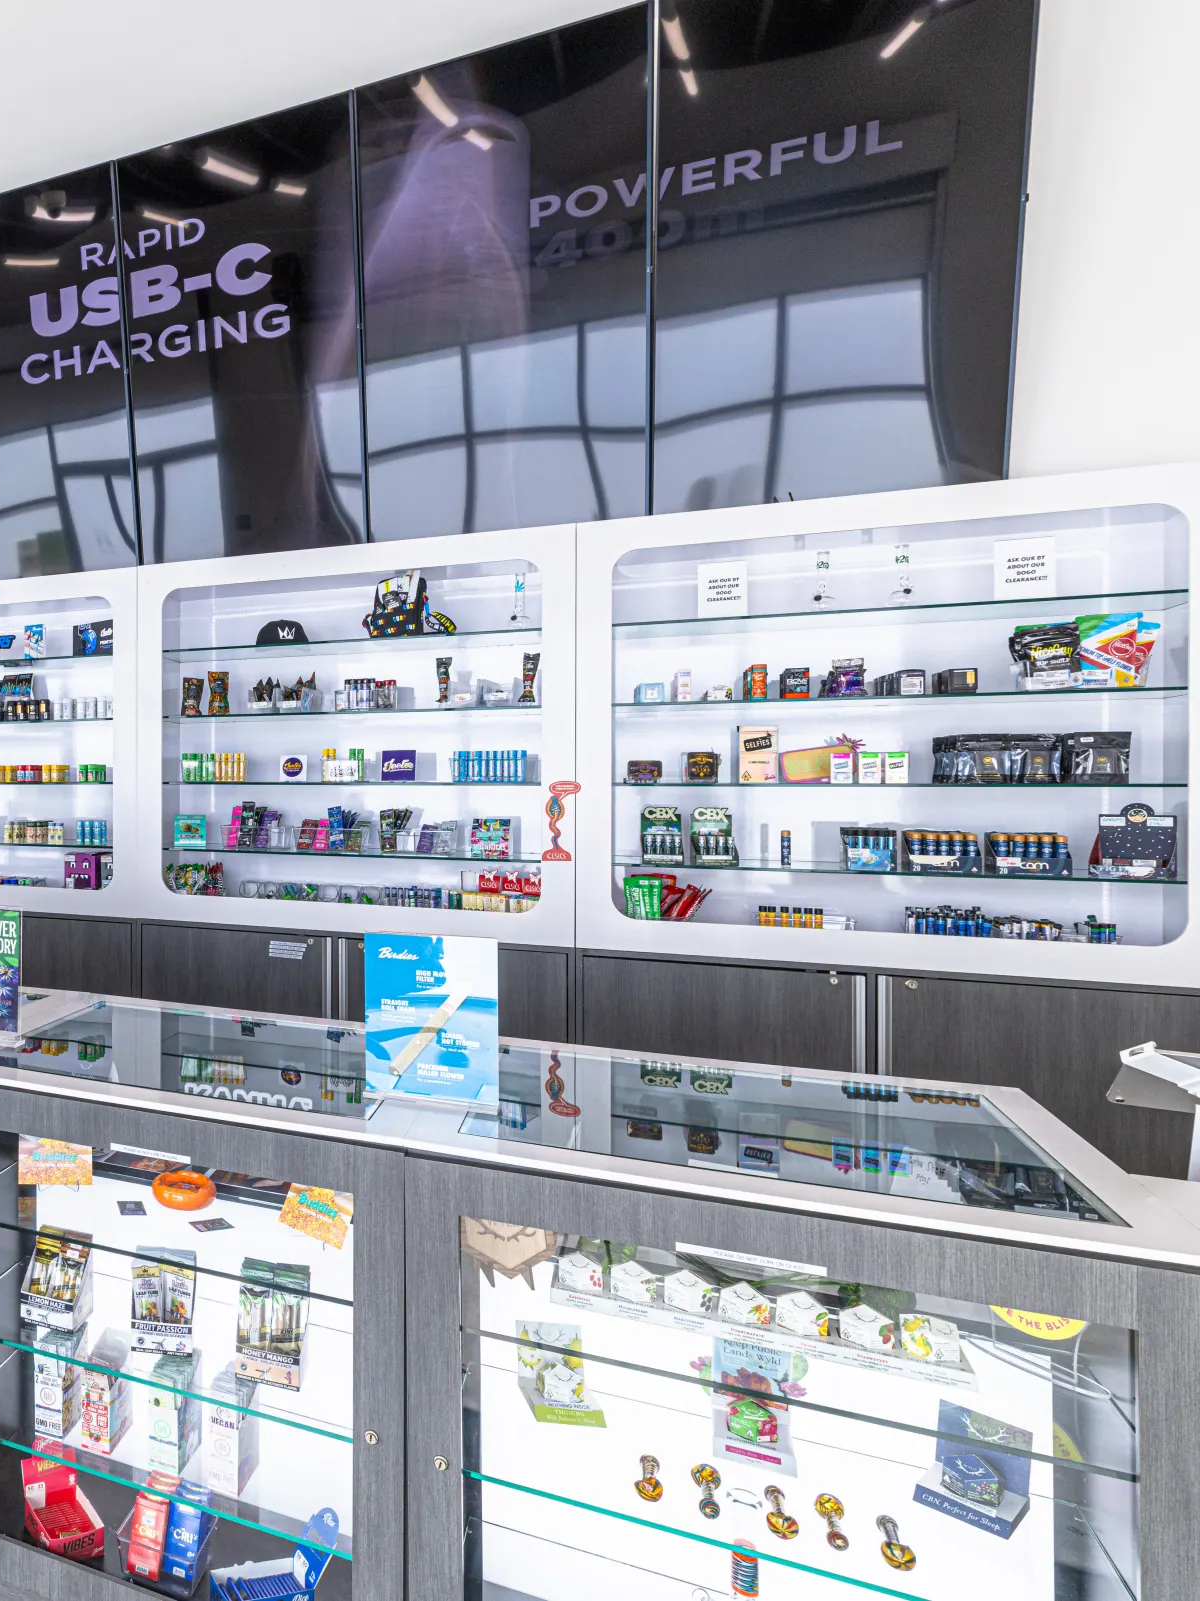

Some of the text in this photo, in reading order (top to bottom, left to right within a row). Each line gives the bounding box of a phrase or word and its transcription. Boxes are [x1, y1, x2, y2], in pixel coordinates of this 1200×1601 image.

[529, 119, 904, 228] POWERFUL
[80, 217, 207, 272] RAPID
[29, 243, 274, 338] USB-C
[19, 303, 292, 386] CHARGING
[1005, 575, 1048, 584] CLEARANCE!!!
[1030, 643, 1073, 661] NiceGuy
[744, 737, 771, 749] SELFIES
[382, 758, 414, 772] Jeeter
[643, 807, 678, 821] CBX
[693, 807, 729, 822] CBX
[547, 852, 567, 860] CLSICS
[912, 864, 921, 872] 20
[999, 867, 1008, 875] 20
[1019, 860, 1050, 870] cam
[480, 880, 498, 889] CLSICS
[504, 882, 521, 891] CLSICS
[378, 946, 420, 961] Birdies
[416, 969, 431, 978] HIGH
[381, 998, 409, 1006] STRAIGHT
[381, 1004, 396, 1012] ROLL
[440, 1071, 465, 1080] FLOWER
[31, 1149, 78, 1163] Buddies
[297, 1191, 339, 1220] Buddies
[713, 1251, 735, 1259] PLEASE
[759, 1258, 774, 1266] LEAN
[28, 1295, 66, 1310] LEMON HAZE
[135, 1322, 189, 1334] FRUIT PASSION
[1018, 1315, 1042, 1331] THE
[242, 1347, 294, 1364] HONEY MANGO
[723, 1346, 782, 1366] Lands Wyld
[36, 1417, 62, 1431] GMO FREE
[210, 1415, 235, 1430] VEGAN
[921, 1493, 941, 1506] CBN.
[943, 1501, 967, 1518] Perfect
[967, 1509, 980, 1523] for
[980, 1517, 1002, 1532] Sleep.
[138, 1525, 157, 1539] CALI
[173, 1528, 194, 1544] CALI
[63, 1533, 96, 1554] VIBES
